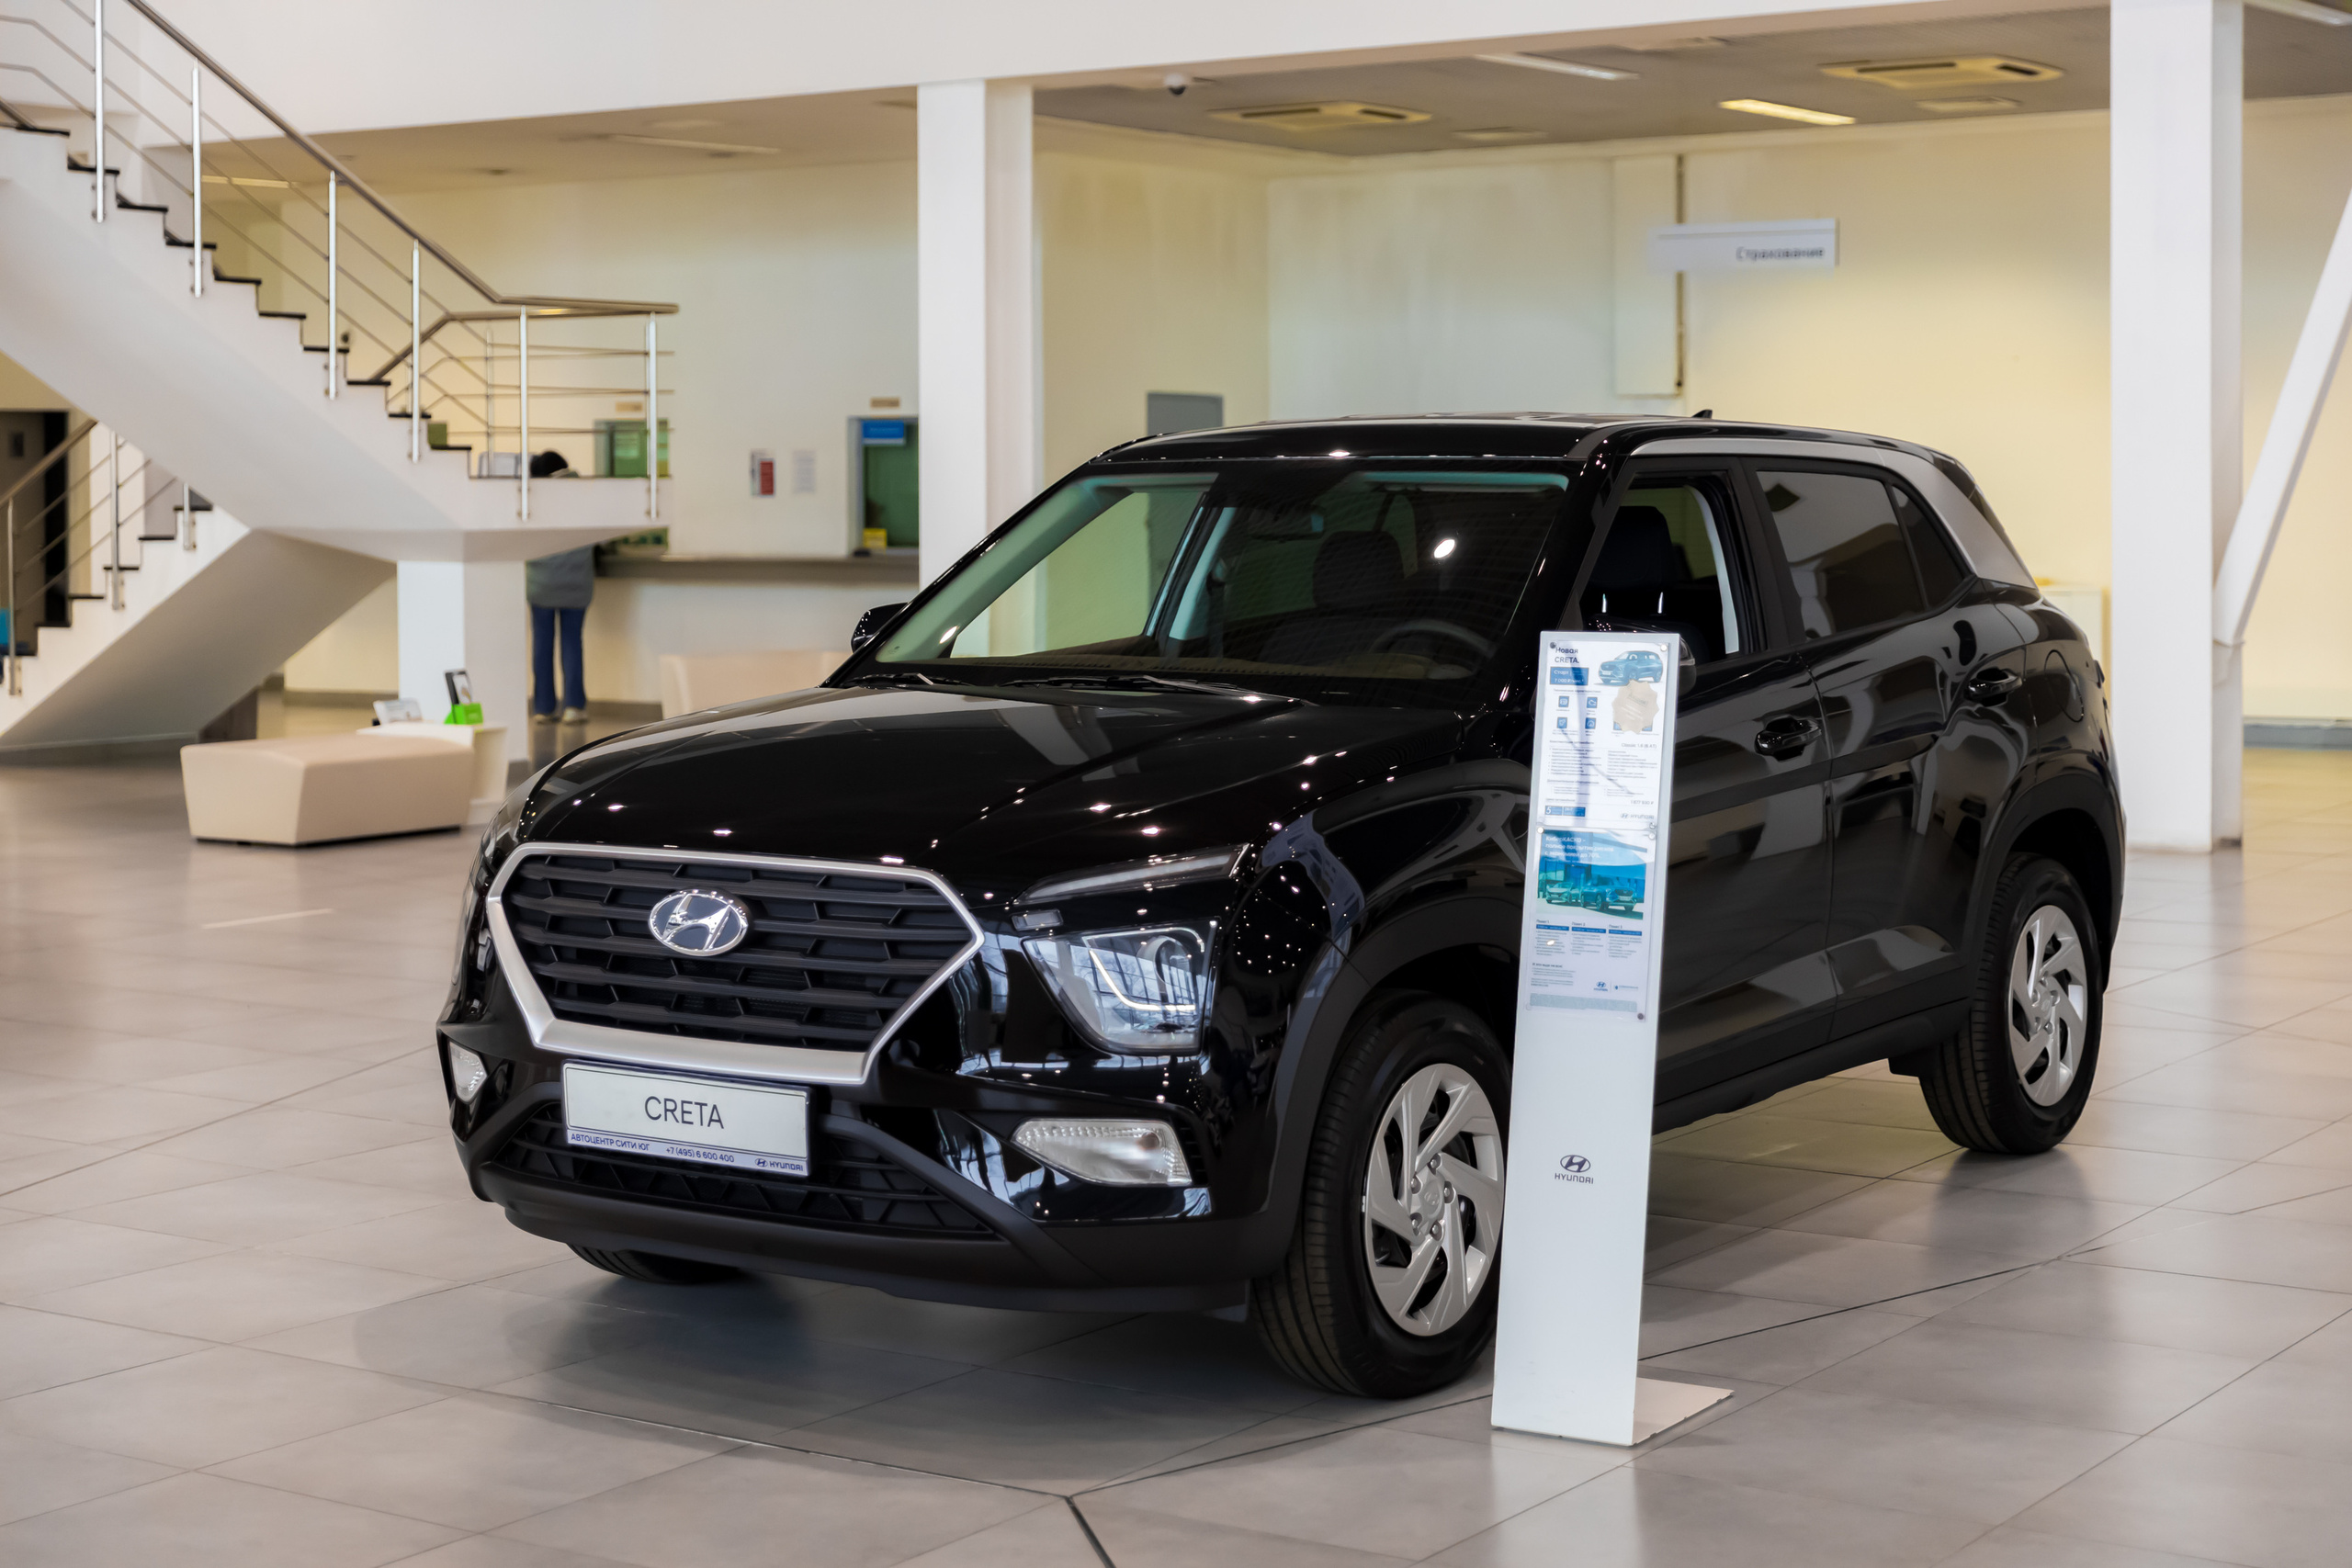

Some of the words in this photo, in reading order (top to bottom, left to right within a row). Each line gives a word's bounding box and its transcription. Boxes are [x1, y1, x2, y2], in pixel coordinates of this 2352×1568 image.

[644, 1095, 725, 1130] CRETA
[571, 1133, 615, 1146] АВТОЦЕНТР
[615, 1139, 638, 1150] СИТИ
[638, 1142, 650, 1152] ЮГ
[666, 1146, 674, 1156] +7
[675, 1146, 695, 1158] (495)
[695, 1149, 701, 1158] 6
[702, 1150, 718, 1161] 600
[718, 1152, 735, 1163] 400
[769, 1160, 804, 1172] HYUNDAI
[1555, 1172, 1594, 1185] HYUNDAI
